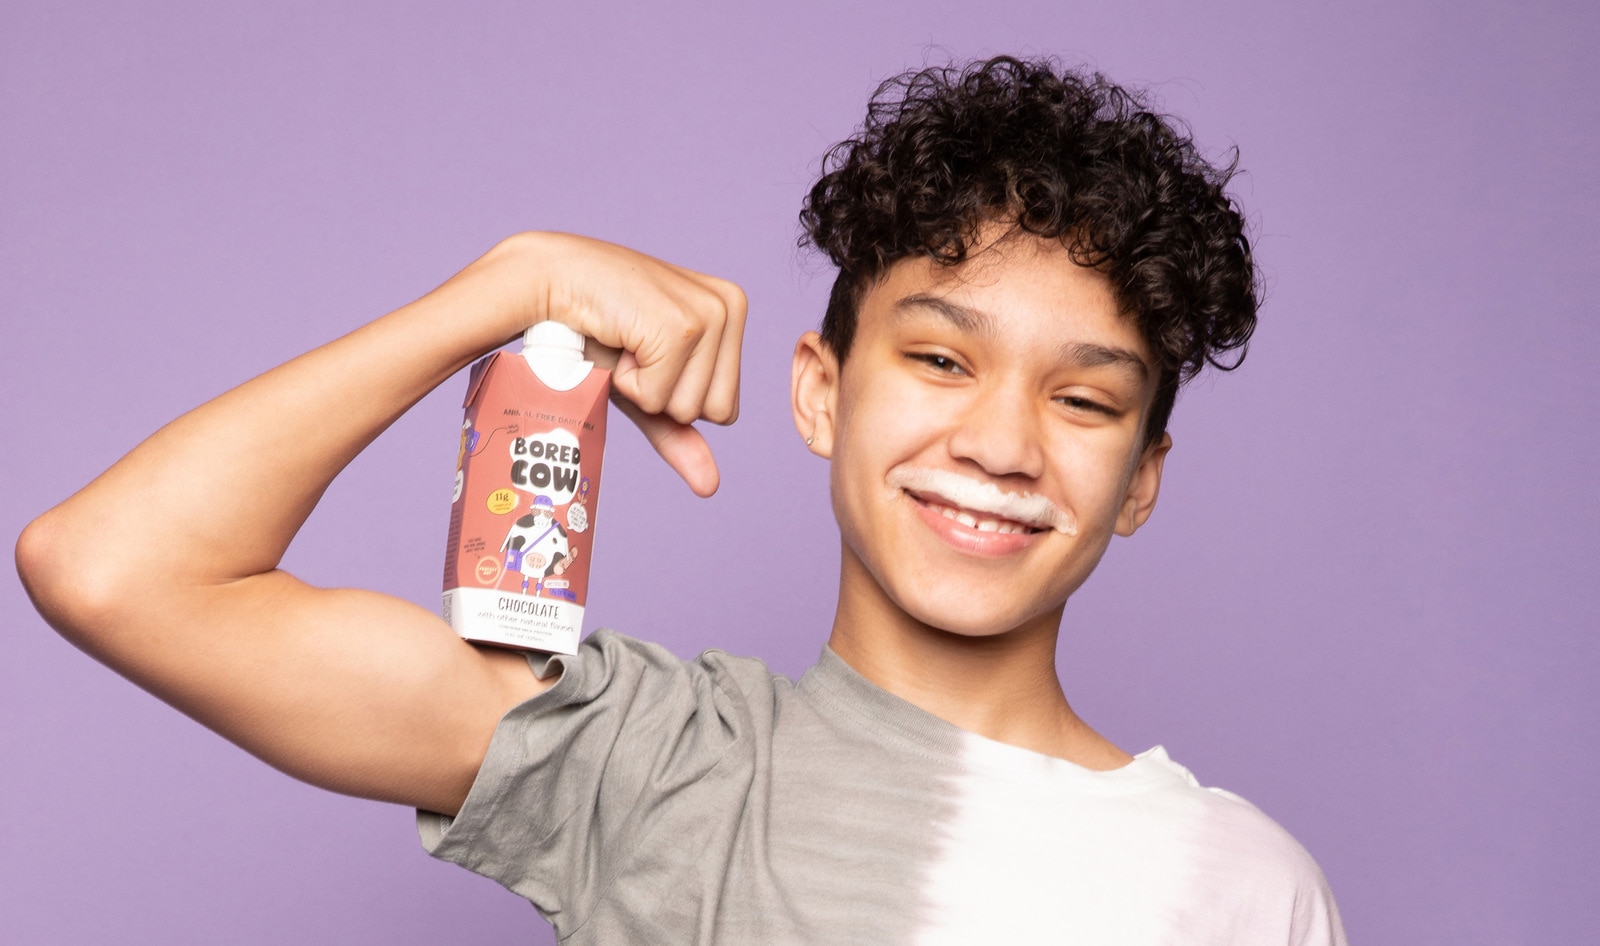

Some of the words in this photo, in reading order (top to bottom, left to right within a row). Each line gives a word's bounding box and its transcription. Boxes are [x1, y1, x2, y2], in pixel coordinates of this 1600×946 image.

[535, 413, 556, 423] FREE
[558, 416, 582, 426] DAIRY
[514, 437, 581, 465] BORED
[511, 459, 578, 493] COW
[498, 597, 560, 619] CHOCOLATE
[520, 618, 548, 628] natural
